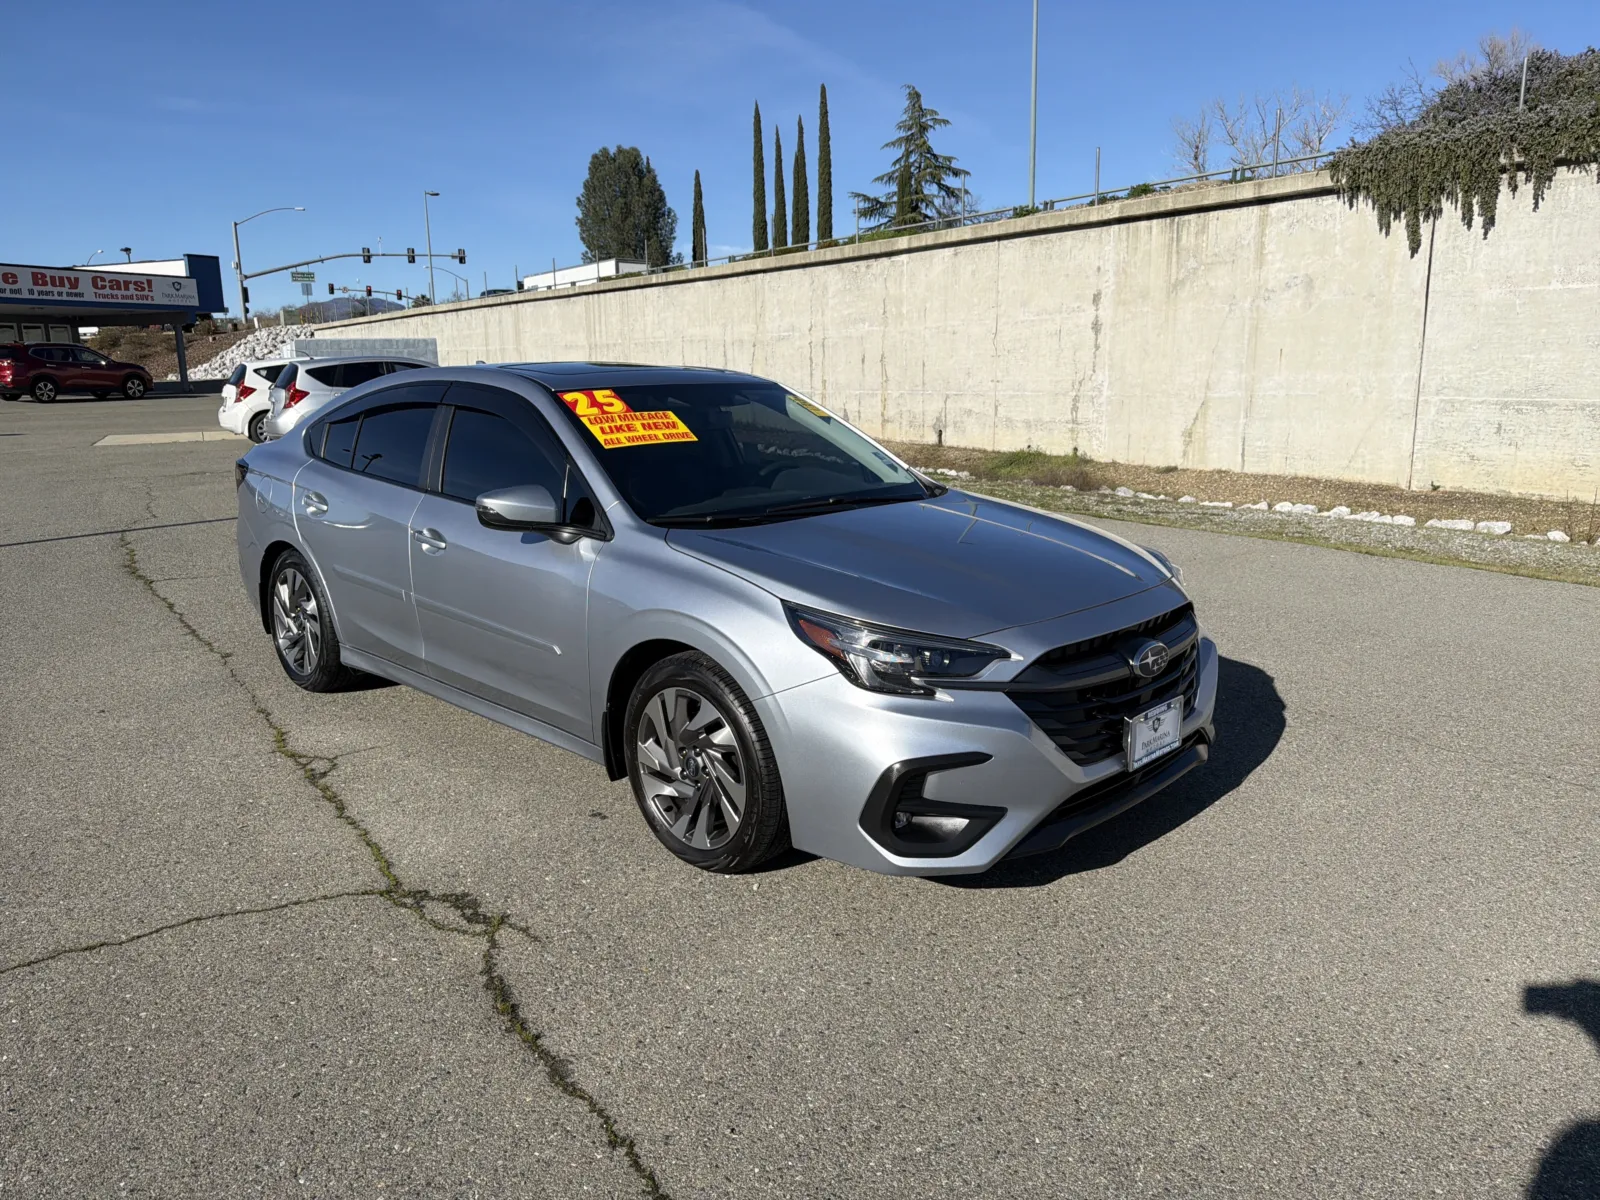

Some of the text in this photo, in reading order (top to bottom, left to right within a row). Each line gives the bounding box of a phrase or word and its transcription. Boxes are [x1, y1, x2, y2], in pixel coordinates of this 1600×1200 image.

[31, 271, 80, 290] Buy
[91, 275, 154, 293] Cars!
[27, 288, 35, 296] 10
[65, 291, 85, 299] newer
[93, 291, 120, 300] Trucks
[135, 294, 155, 302] SUV's
[562, 389, 626, 415] 25
[587, 412, 672, 425] LOW MILEAGE
[599, 421, 678, 435] LIKE NEW
[603, 432, 693, 447] ALL WHEEL DRIVE
